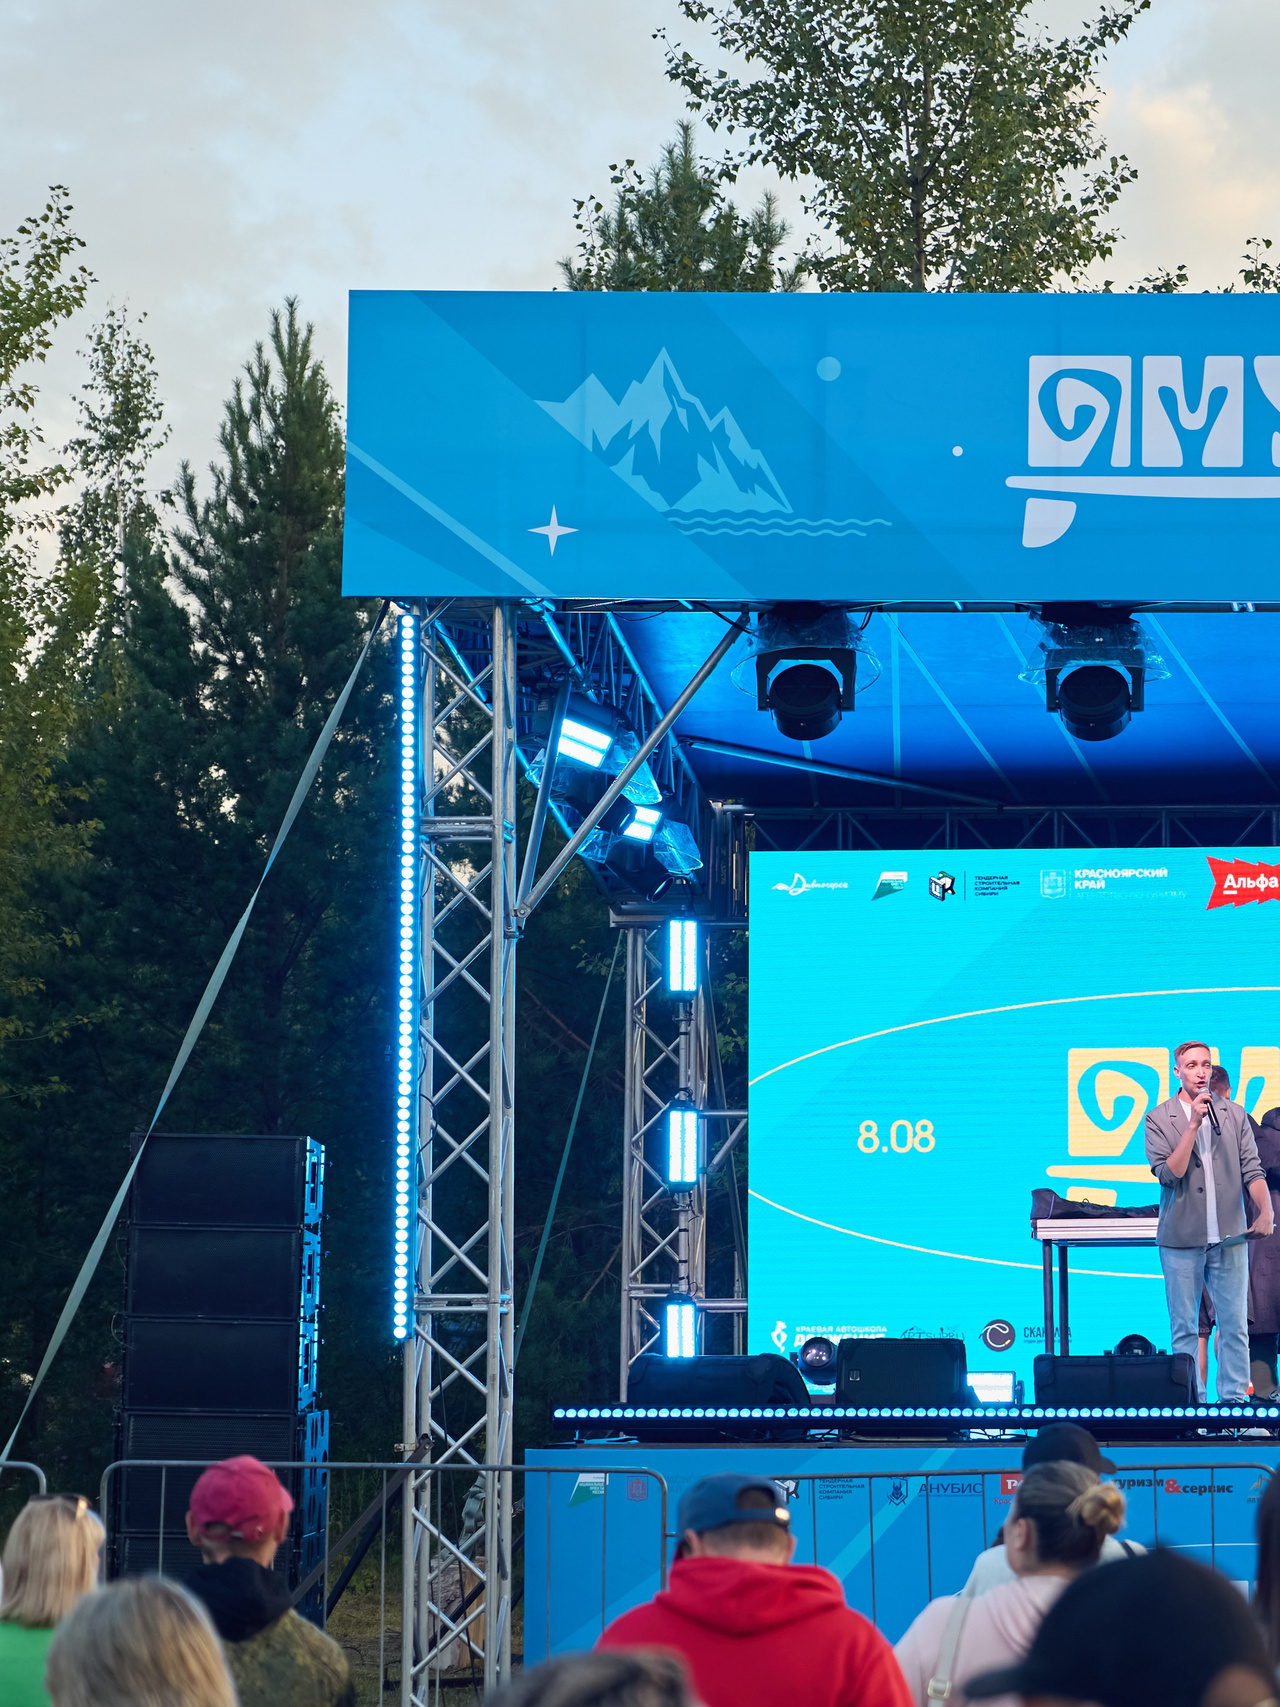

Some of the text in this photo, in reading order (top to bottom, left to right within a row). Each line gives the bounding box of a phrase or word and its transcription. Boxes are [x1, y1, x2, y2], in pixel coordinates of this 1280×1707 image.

[1074, 867, 1168, 878] КРАСНОЯРСКИЙ
[1074, 879, 1106, 889] КРАЙ
[1223, 873, 1279, 893] Альфа
[857, 1119, 936, 1153] 8.08
[918, 1482, 983, 1494] АНУБИС
